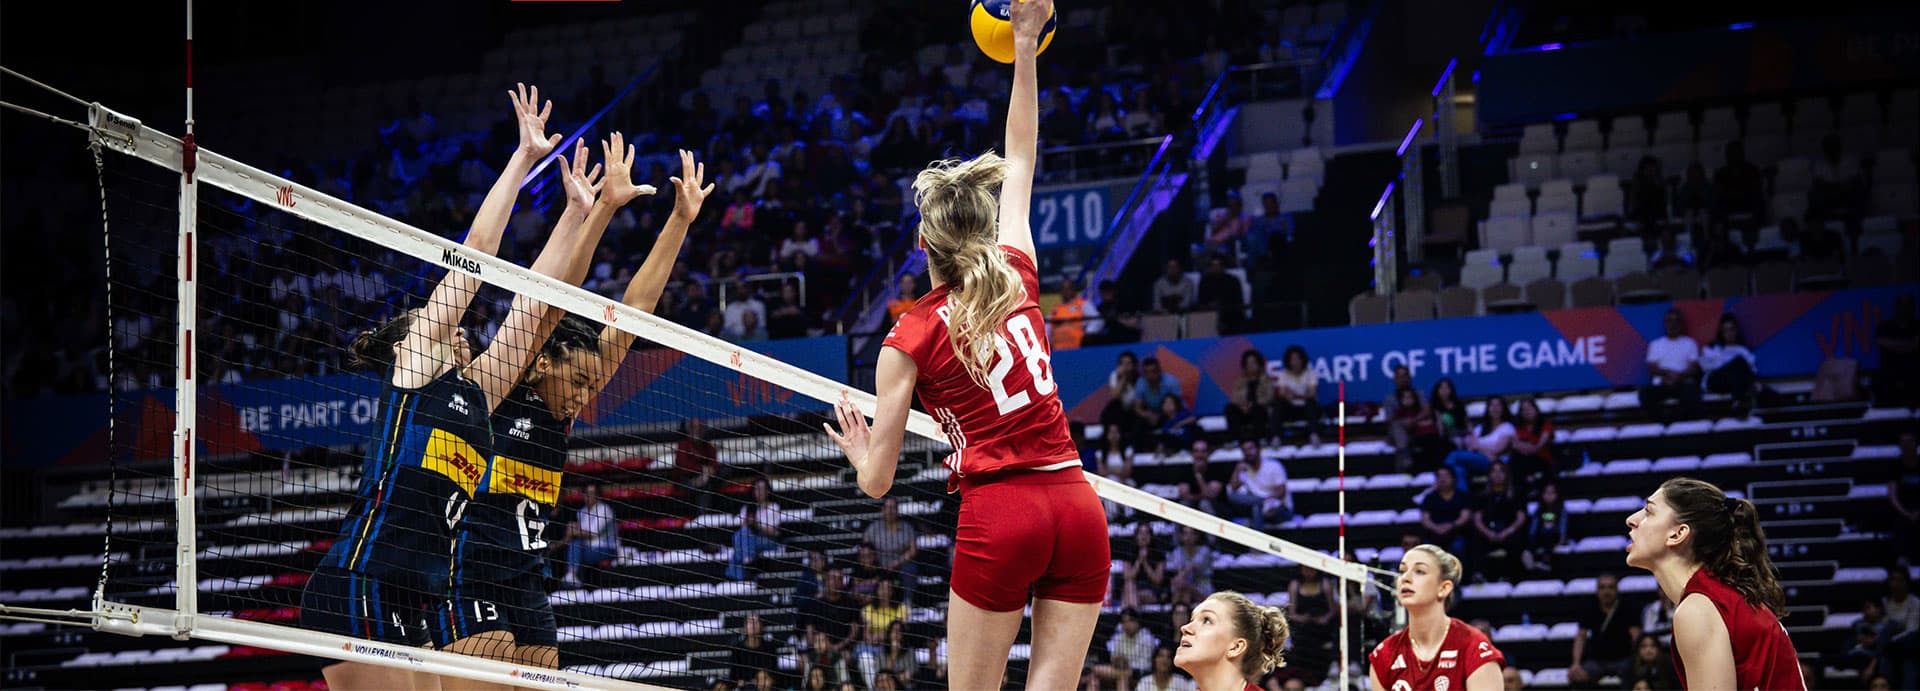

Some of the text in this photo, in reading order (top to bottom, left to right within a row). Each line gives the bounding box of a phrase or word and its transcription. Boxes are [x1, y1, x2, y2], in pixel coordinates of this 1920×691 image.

[276, 185, 297, 208] VNL
[1039, 191, 1103, 243] 210
[442, 248, 482, 275] MIKASA
[974, 314, 1054, 416] 28
[1309, 353, 1373, 382] ART
[1381, 349, 1426, 378] OF
[1434, 344, 1498, 374] THE
[1507, 335, 1607, 369] GAME
[240, 406, 272, 433] BE
[280, 401, 346, 430] PART
[473, 600, 500, 623] 13
